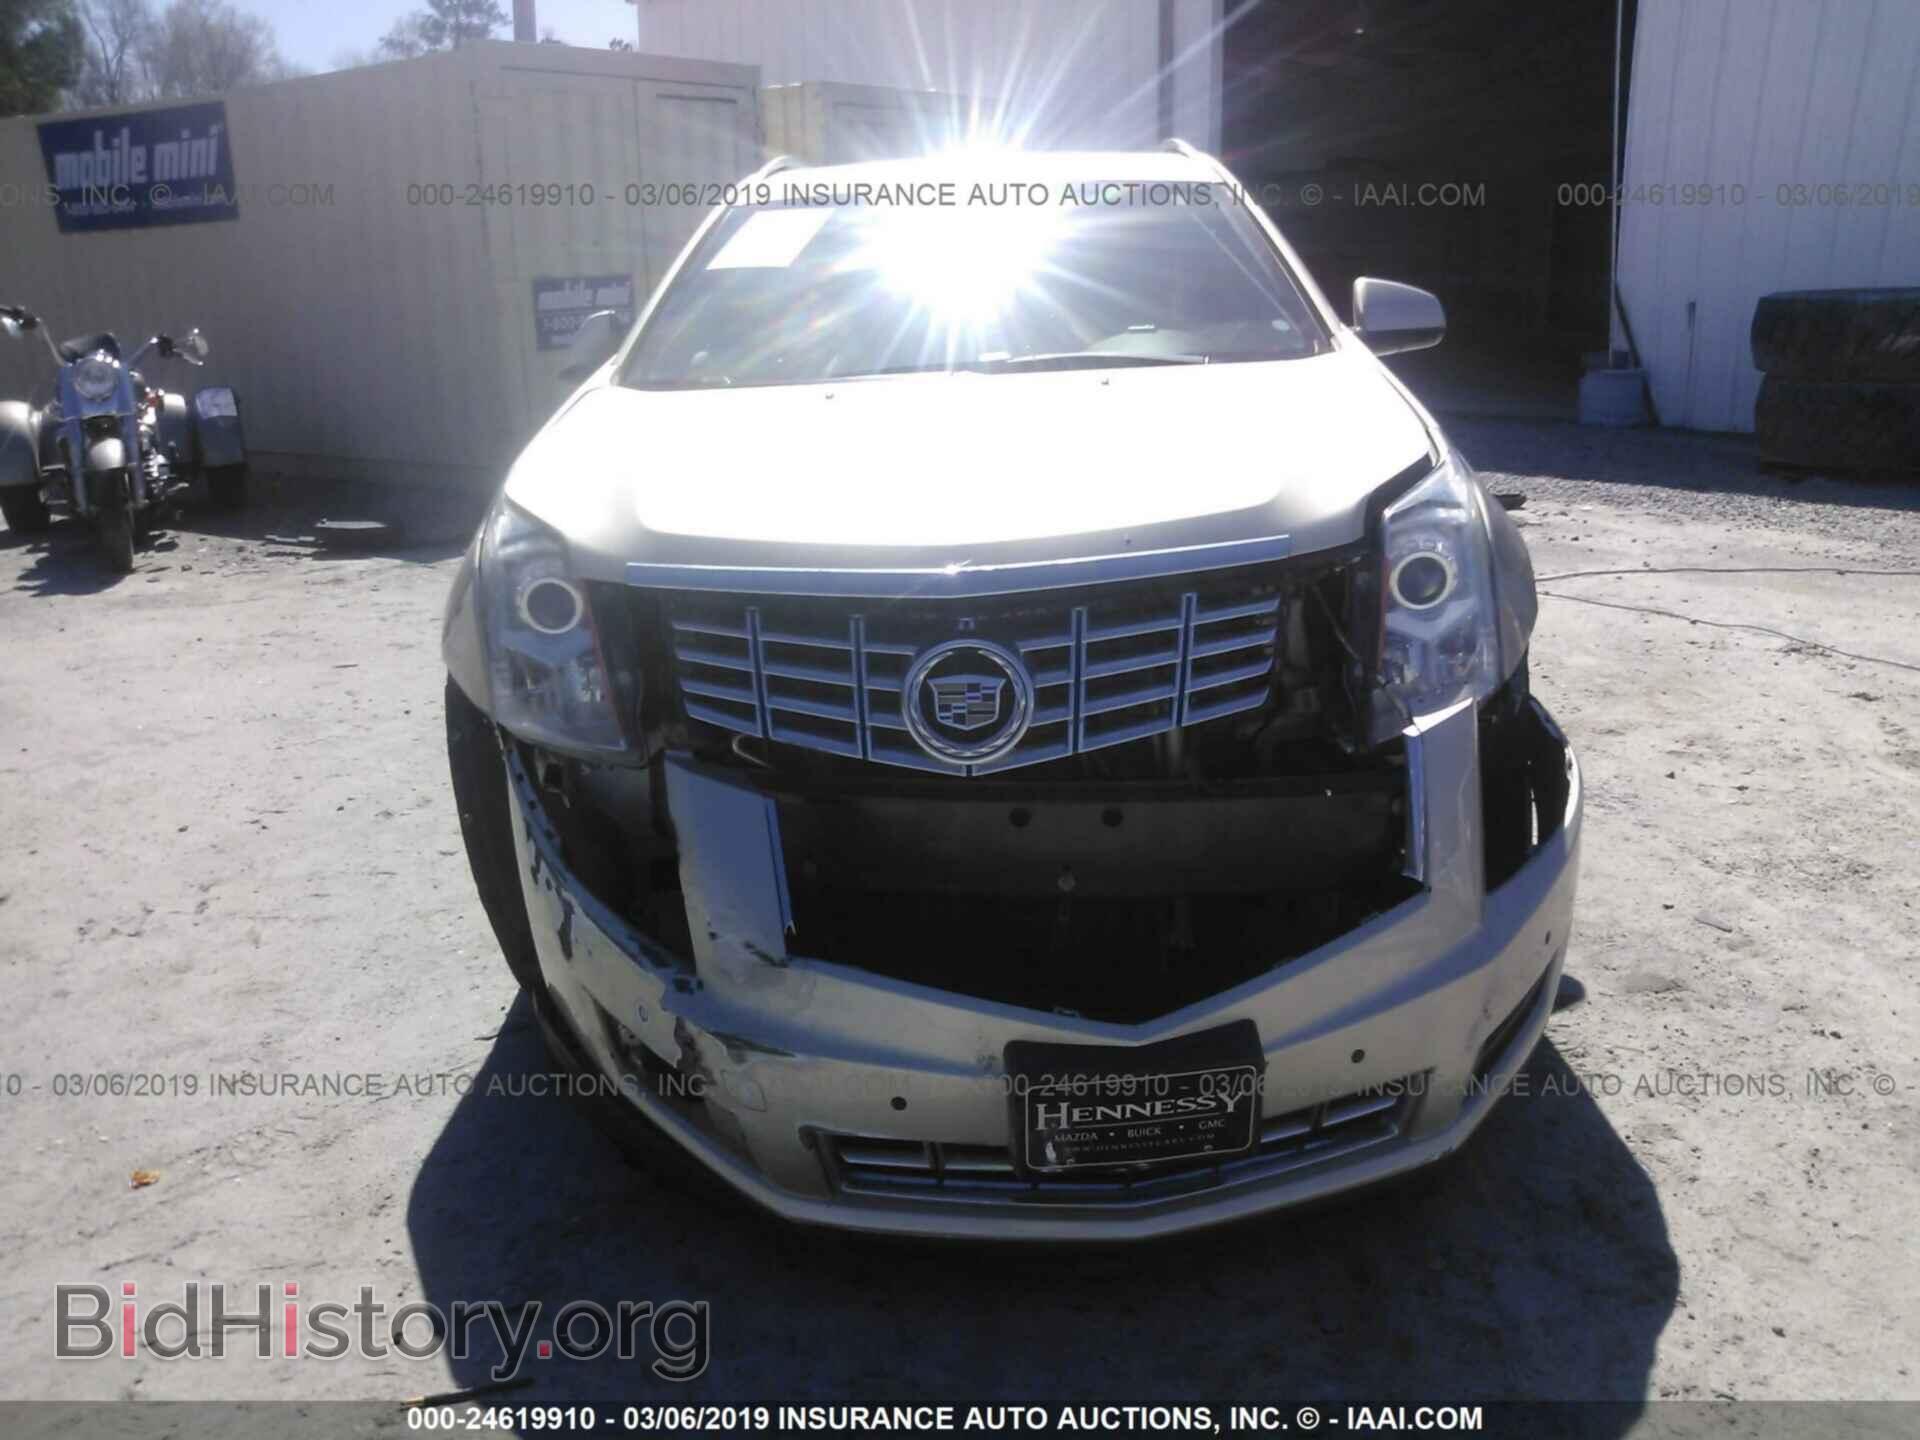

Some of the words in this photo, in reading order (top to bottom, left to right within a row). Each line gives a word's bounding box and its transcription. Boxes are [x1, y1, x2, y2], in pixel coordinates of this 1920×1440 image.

[54, 126, 148, 190] mobile
[153, 123, 223, 181] mini
[1036, 1090, 1242, 1131] HENNESSY
[1055, 1132, 1098, 1141] MAZDA
[1128, 1128, 1161, 1137] BUICK
[1198, 1120, 1225, 1130] GMC
